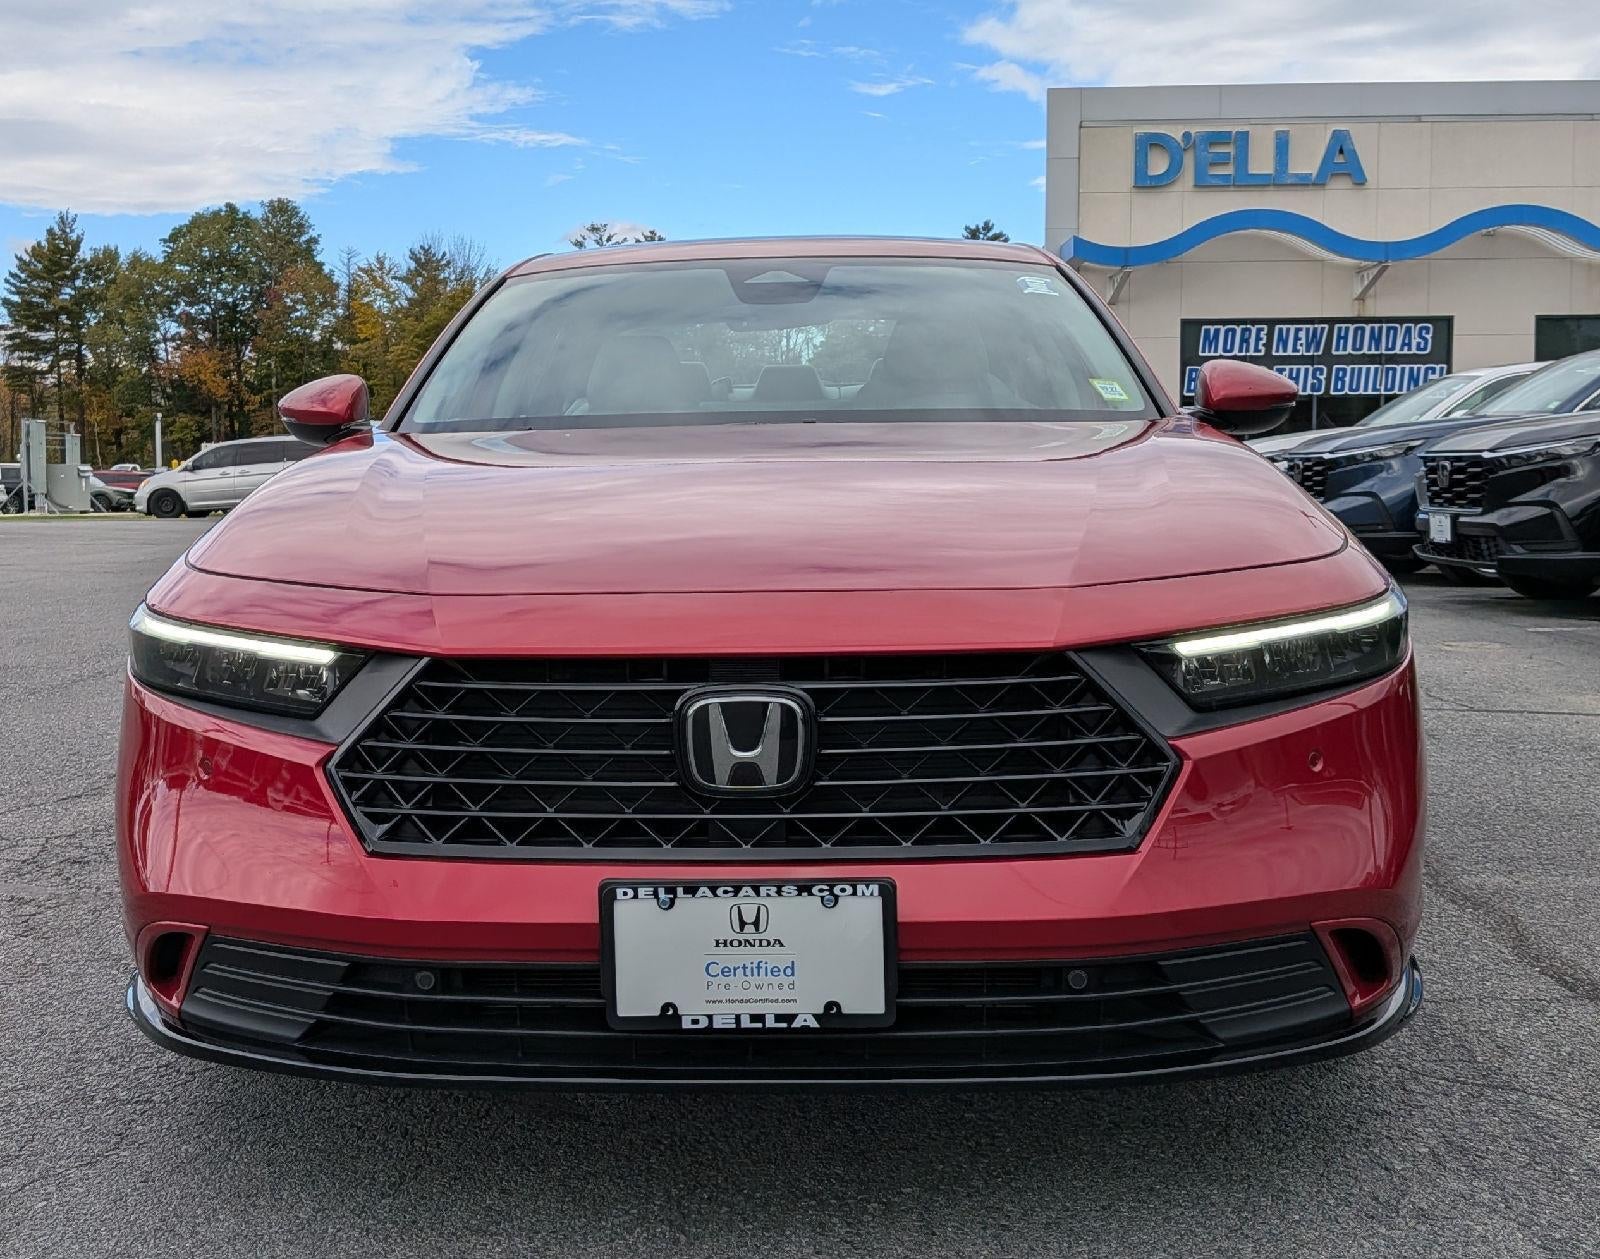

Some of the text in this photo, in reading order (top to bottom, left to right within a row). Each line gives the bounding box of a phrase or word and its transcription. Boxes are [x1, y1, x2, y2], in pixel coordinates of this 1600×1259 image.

[1133, 129, 1367, 187] D'ELLA
[1199, 323, 1433, 355] MORE NEW HONDAS
[615, 884, 880, 900] DELLACARS.COM
[713, 938, 786, 948] HONDA
[704, 960, 796, 978] Certified
[706, 979, 796, 991] Pre-Owned
[704, 997, 798, 1005] www.HondaCertified.com
[681, 1013, 820, 1029] DELLA
